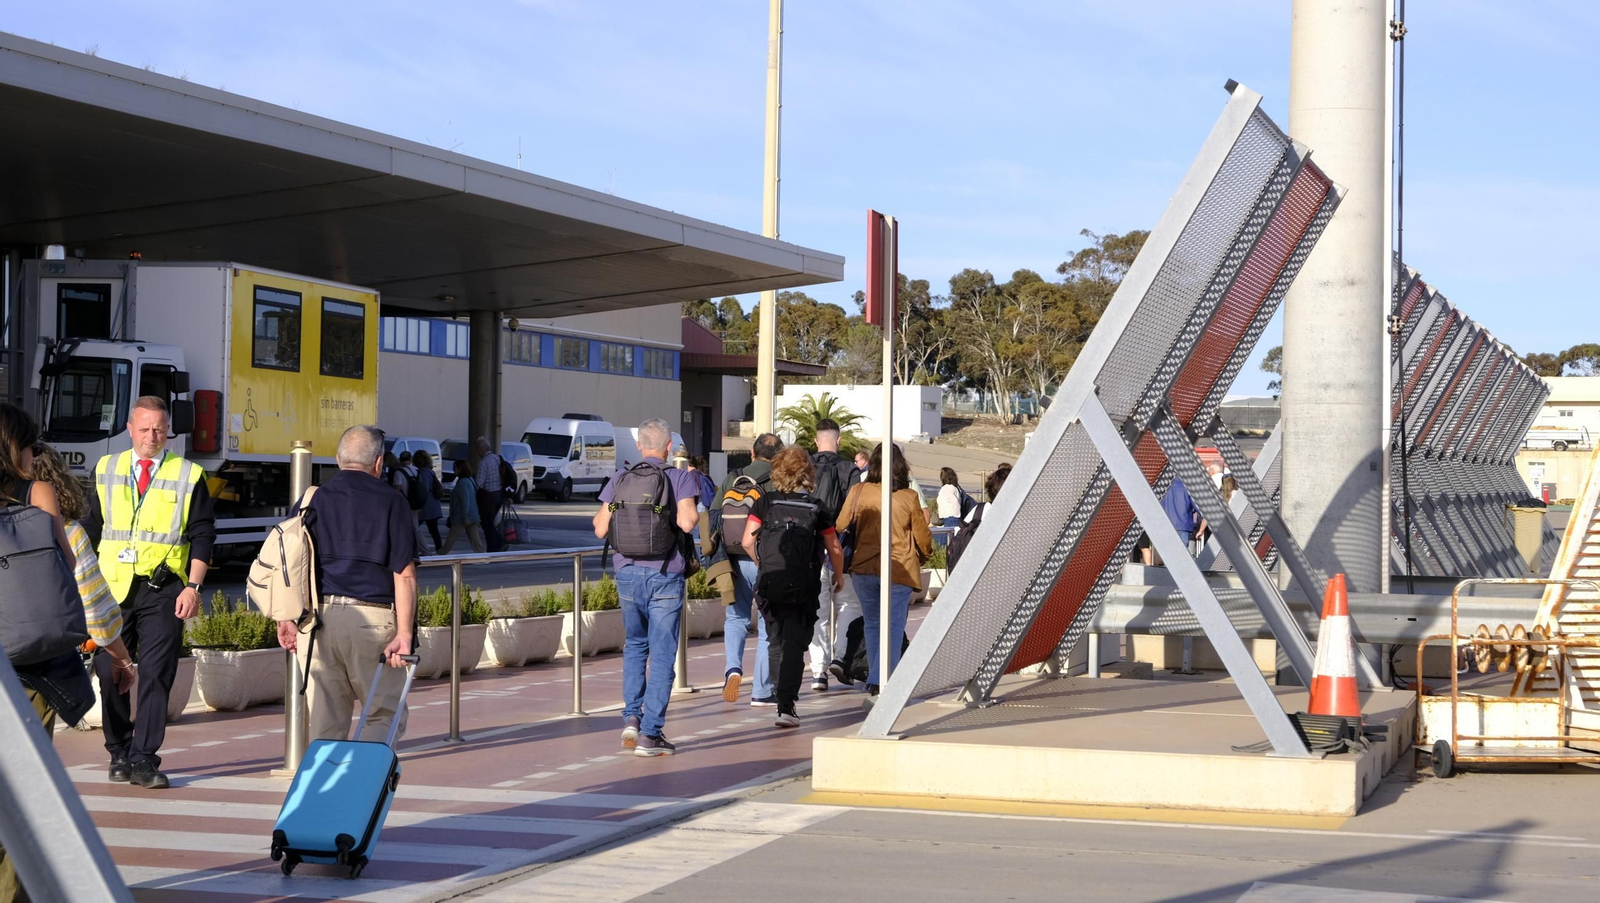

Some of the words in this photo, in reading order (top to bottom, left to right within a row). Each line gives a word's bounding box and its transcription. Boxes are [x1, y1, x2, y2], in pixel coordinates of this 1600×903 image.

[321, 396, 330, 409] sin
[331, 396, 355, 411] barreras
[60, 451, 86, 466] TLD
